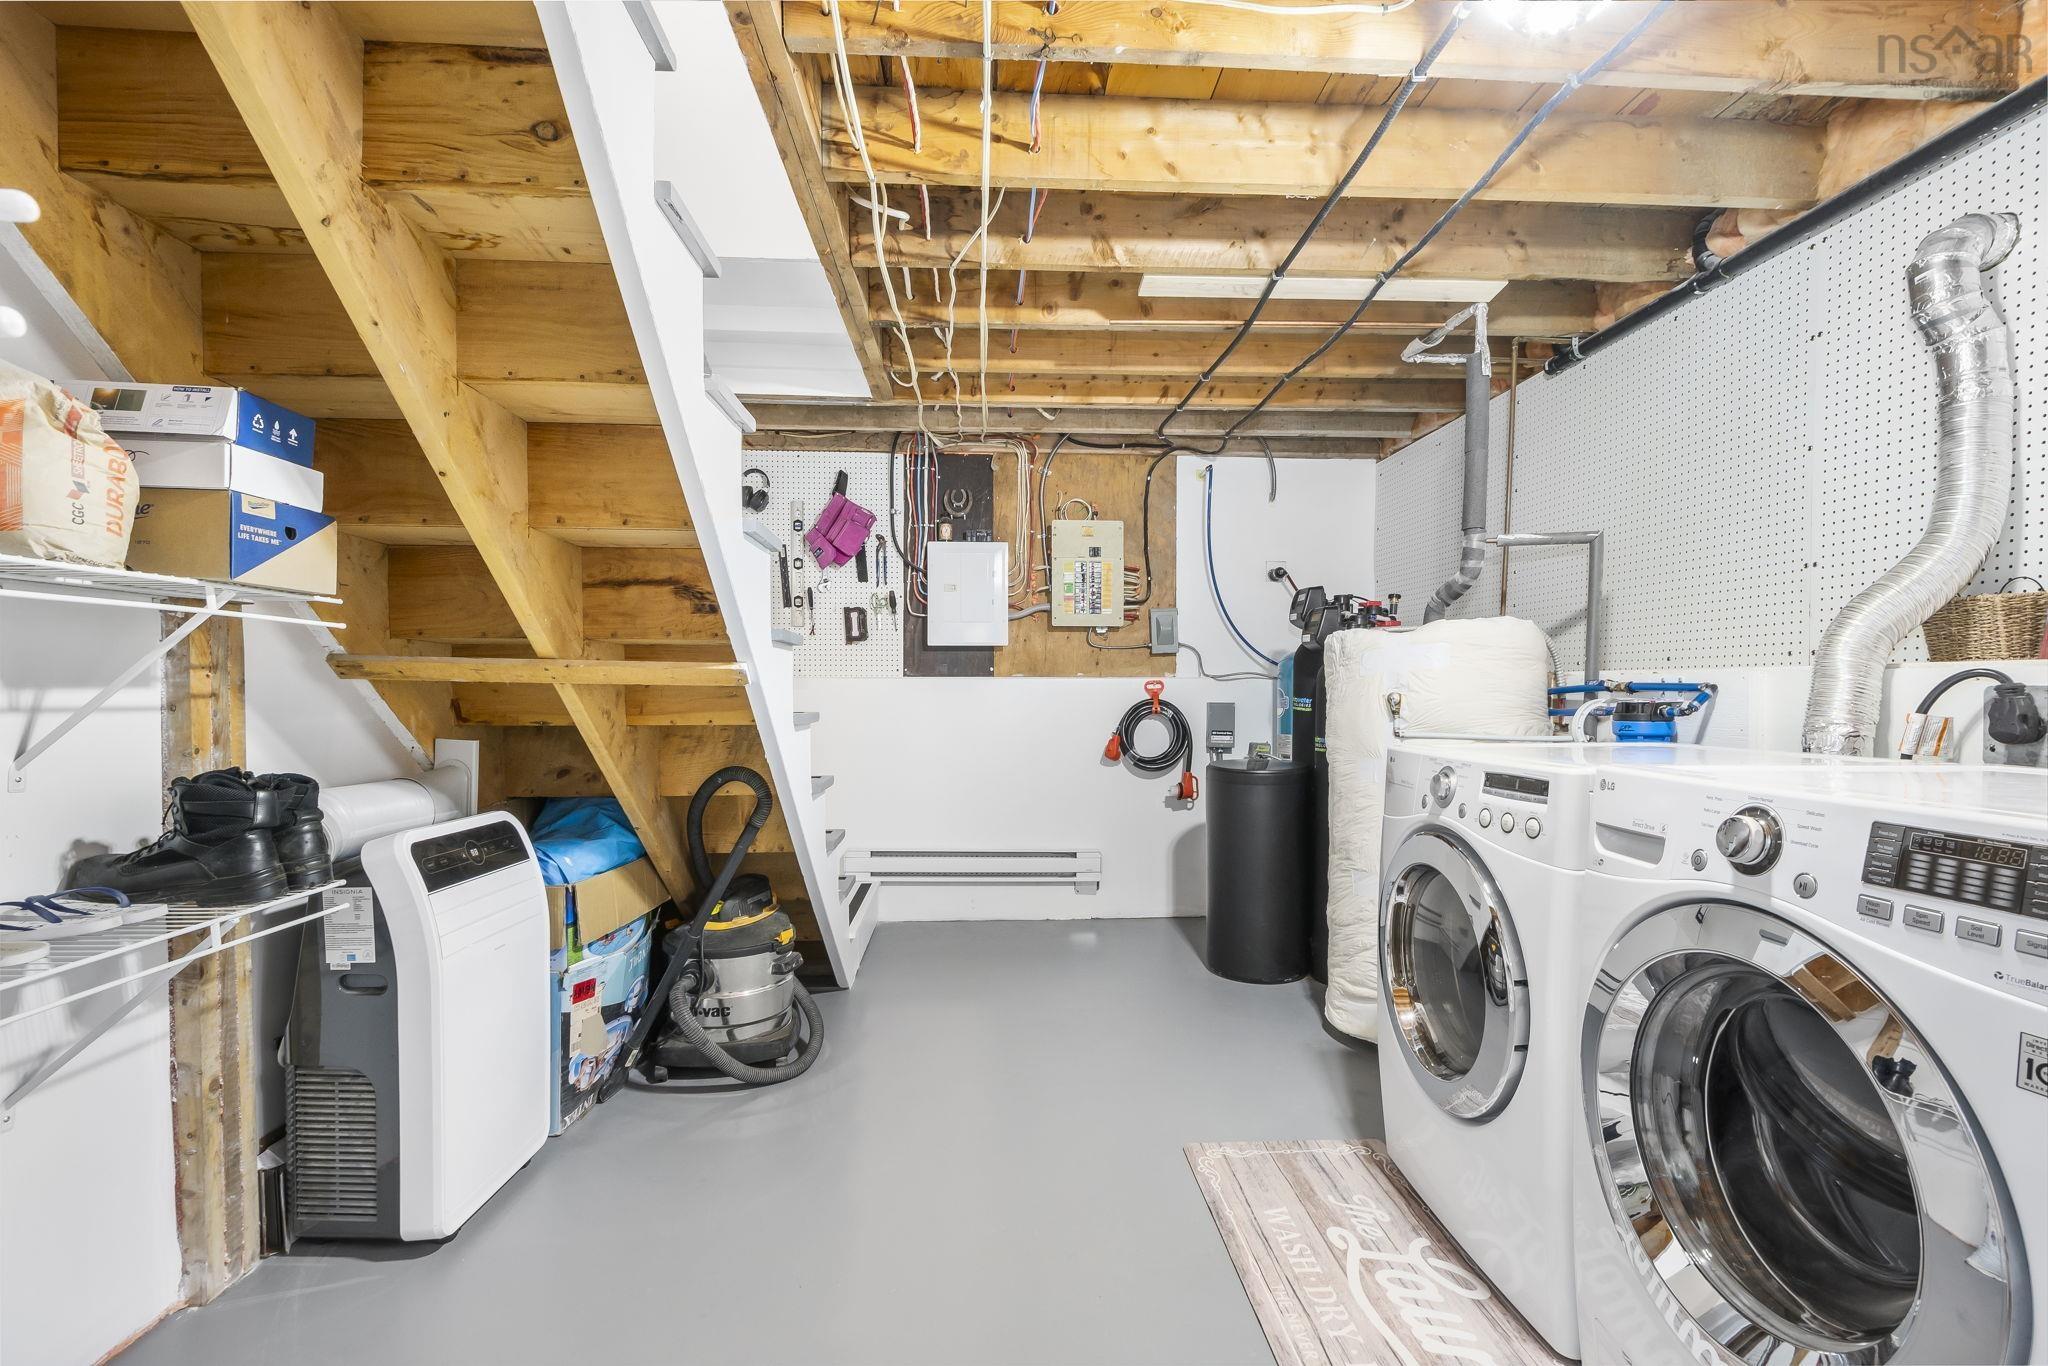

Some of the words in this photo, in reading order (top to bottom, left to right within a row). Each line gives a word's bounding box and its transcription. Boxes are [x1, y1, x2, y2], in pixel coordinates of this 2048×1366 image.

[72, 502, 85, 525] CGC
[240, 524, 277, 537] EVERYWHERE
[237, 532, 250, 540] LIFE
[251, 534, 269, 544] TAKES
[1607, 781, 1616, 791] LG
[1865, 905, 1879, 914] Temp
[1911, 917, 1931, 926] Speed
[1971, 924, 1982, 932] Soil
[1967, 931, 1984, 939] Level
[1328, 1194, 1390, 1240] The
[1263, 1206, 1323, 1276] WASH
[1303, 1285, 1364, 1344] DRY
